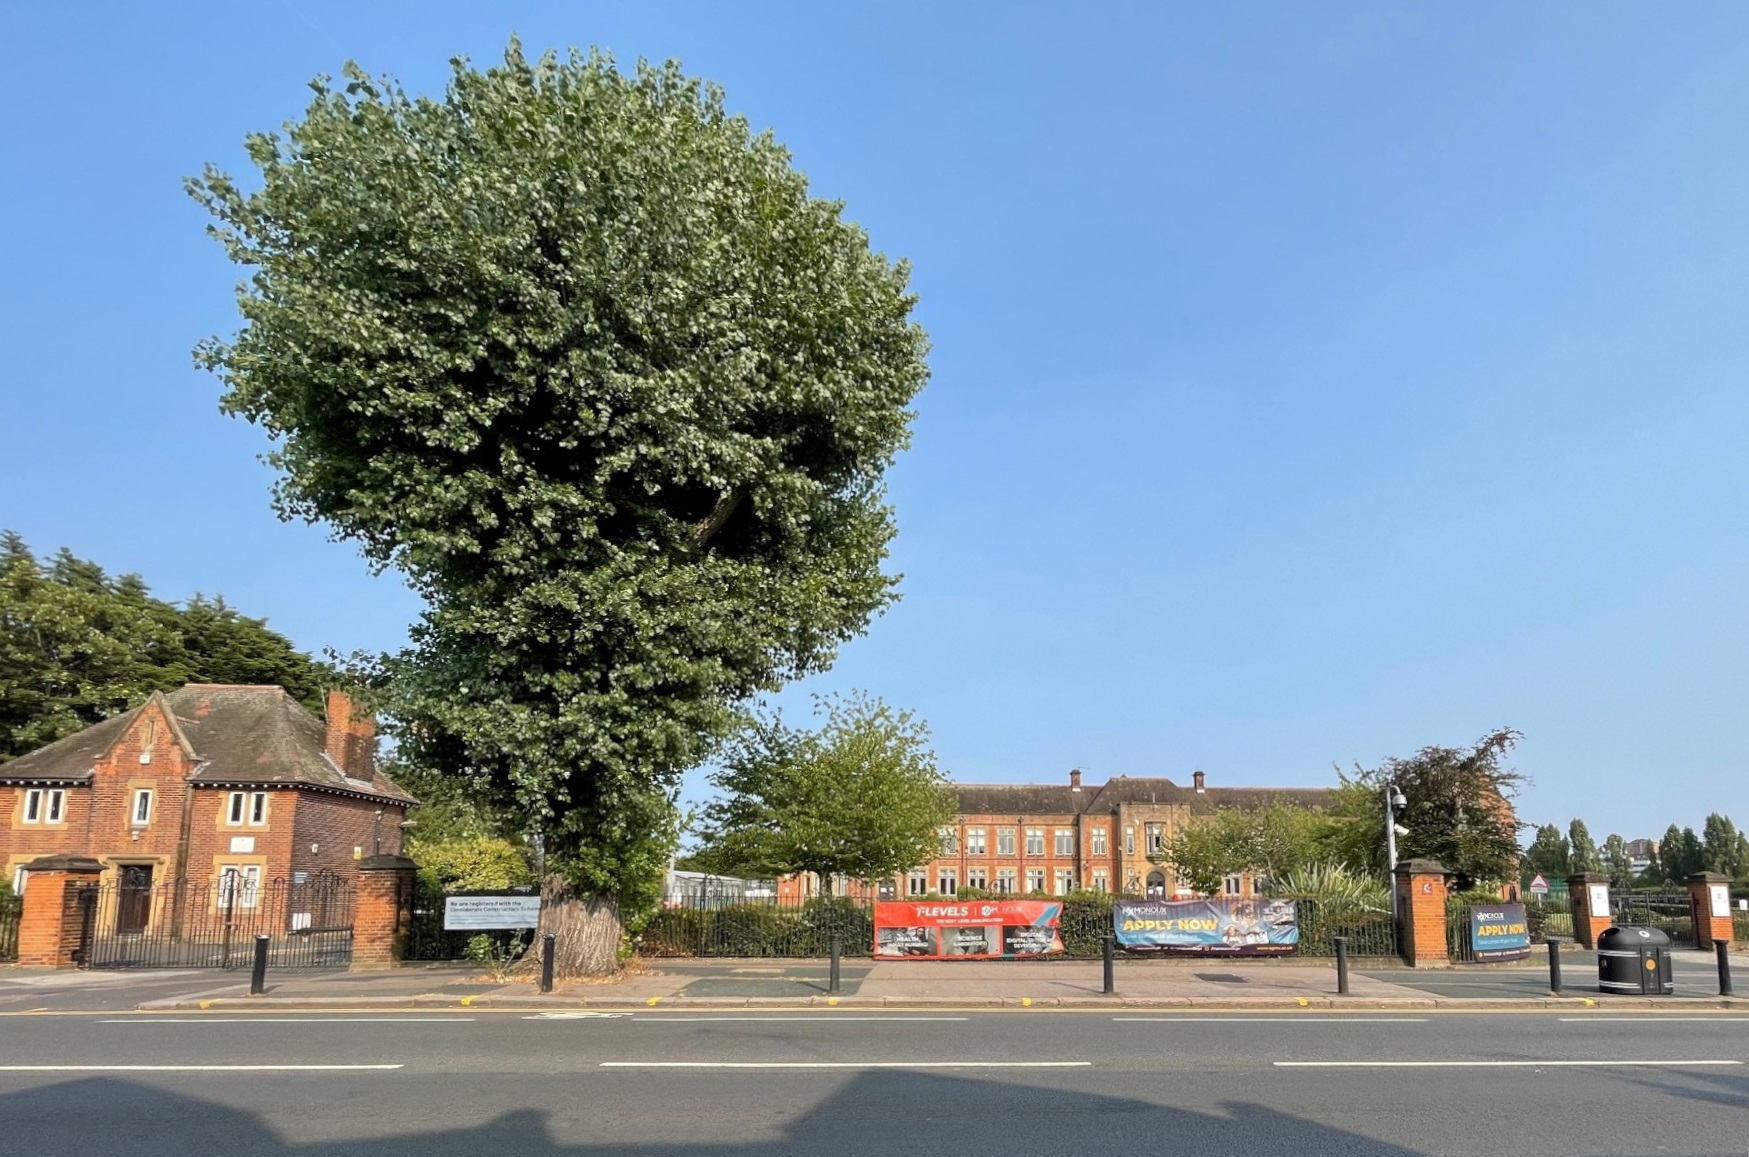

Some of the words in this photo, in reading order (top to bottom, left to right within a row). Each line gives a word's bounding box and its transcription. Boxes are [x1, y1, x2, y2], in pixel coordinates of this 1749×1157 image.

[1122, 920, 1174, 931] APPLY
[1178, 919, 1218, 931] NOW
[1478, 924, 1508, 936] APPLY
[1508, 923, 1526, 935] NOW
